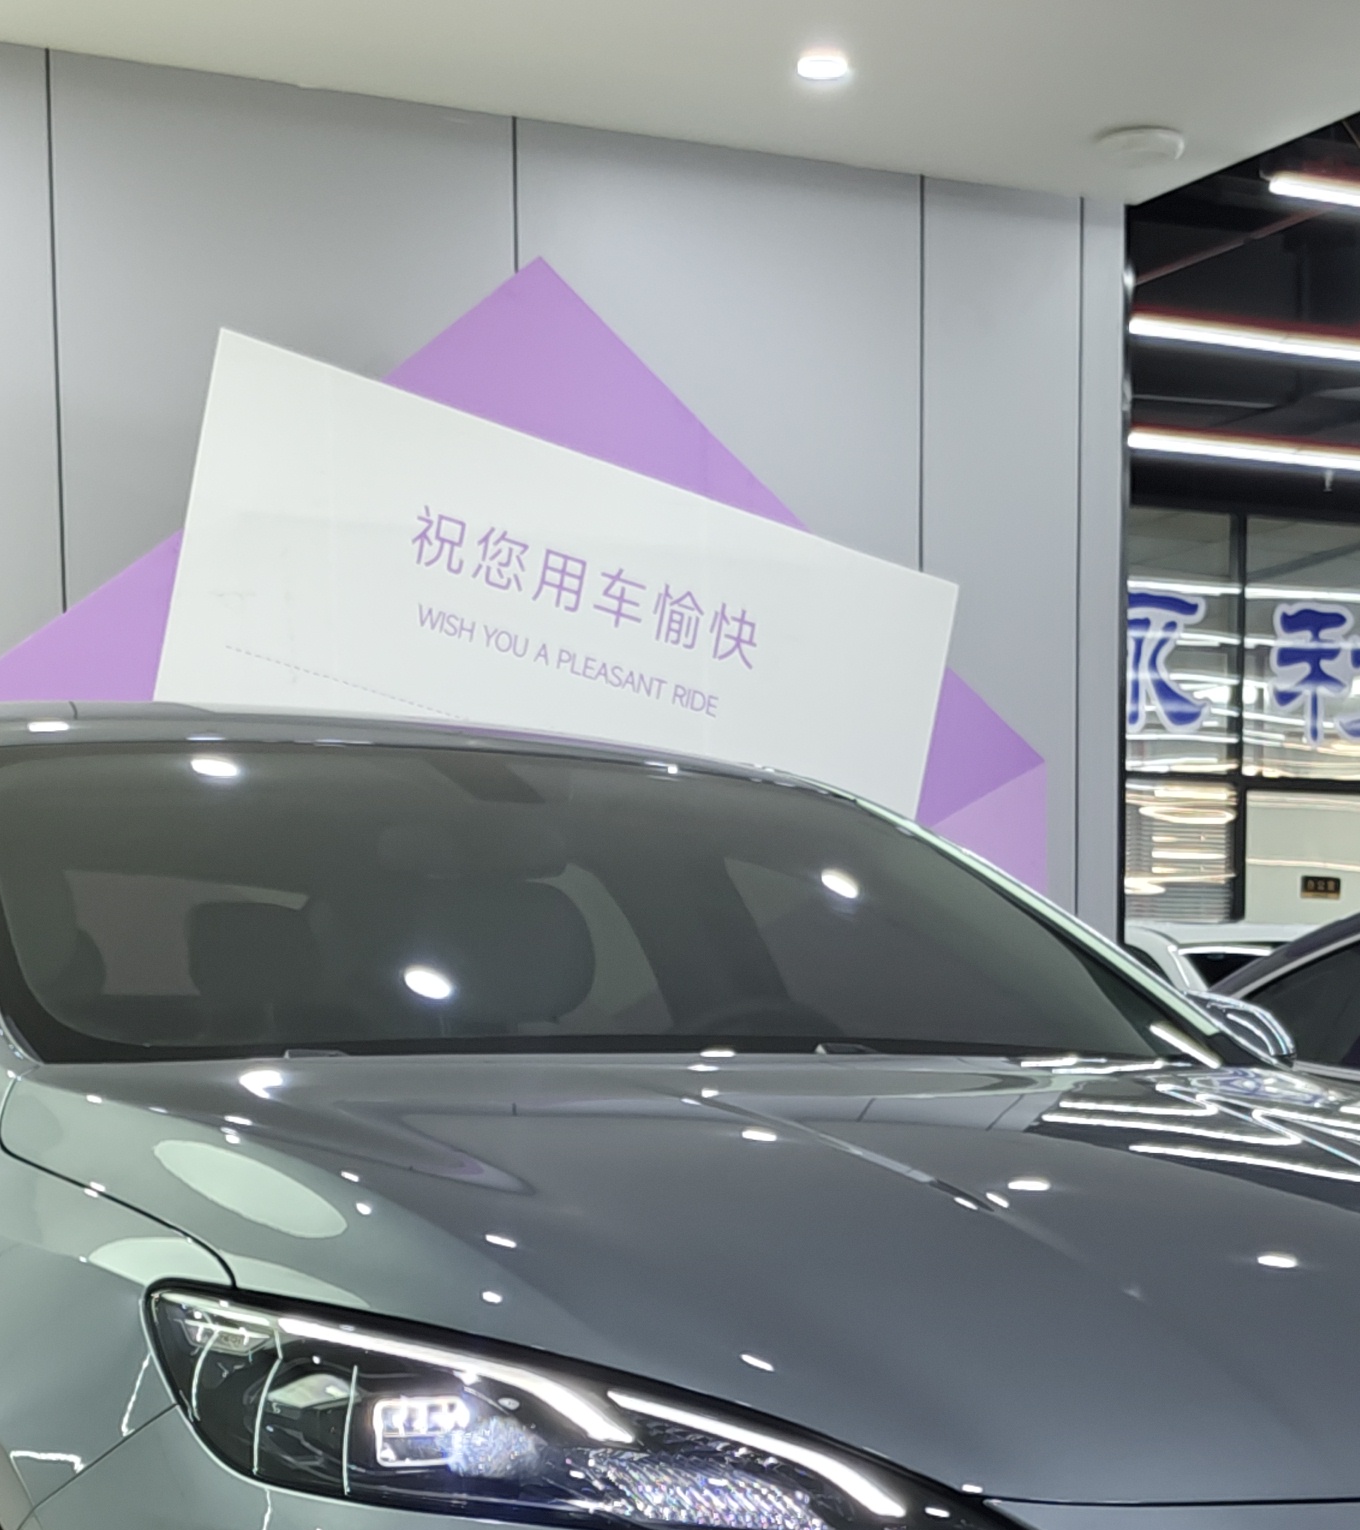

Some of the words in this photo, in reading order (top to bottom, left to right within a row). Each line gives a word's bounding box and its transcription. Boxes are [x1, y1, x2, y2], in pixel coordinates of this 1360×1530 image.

[411, 504, 759, 671] 祝您用车愉快
[417, 601, 477, 644] WISH
[482, 623, 531, 659] YOU
[533, 642, 551, 667] A
[555, 648, 669, 701] PLEASANT
[671, 684, 721, 719] RIDE
